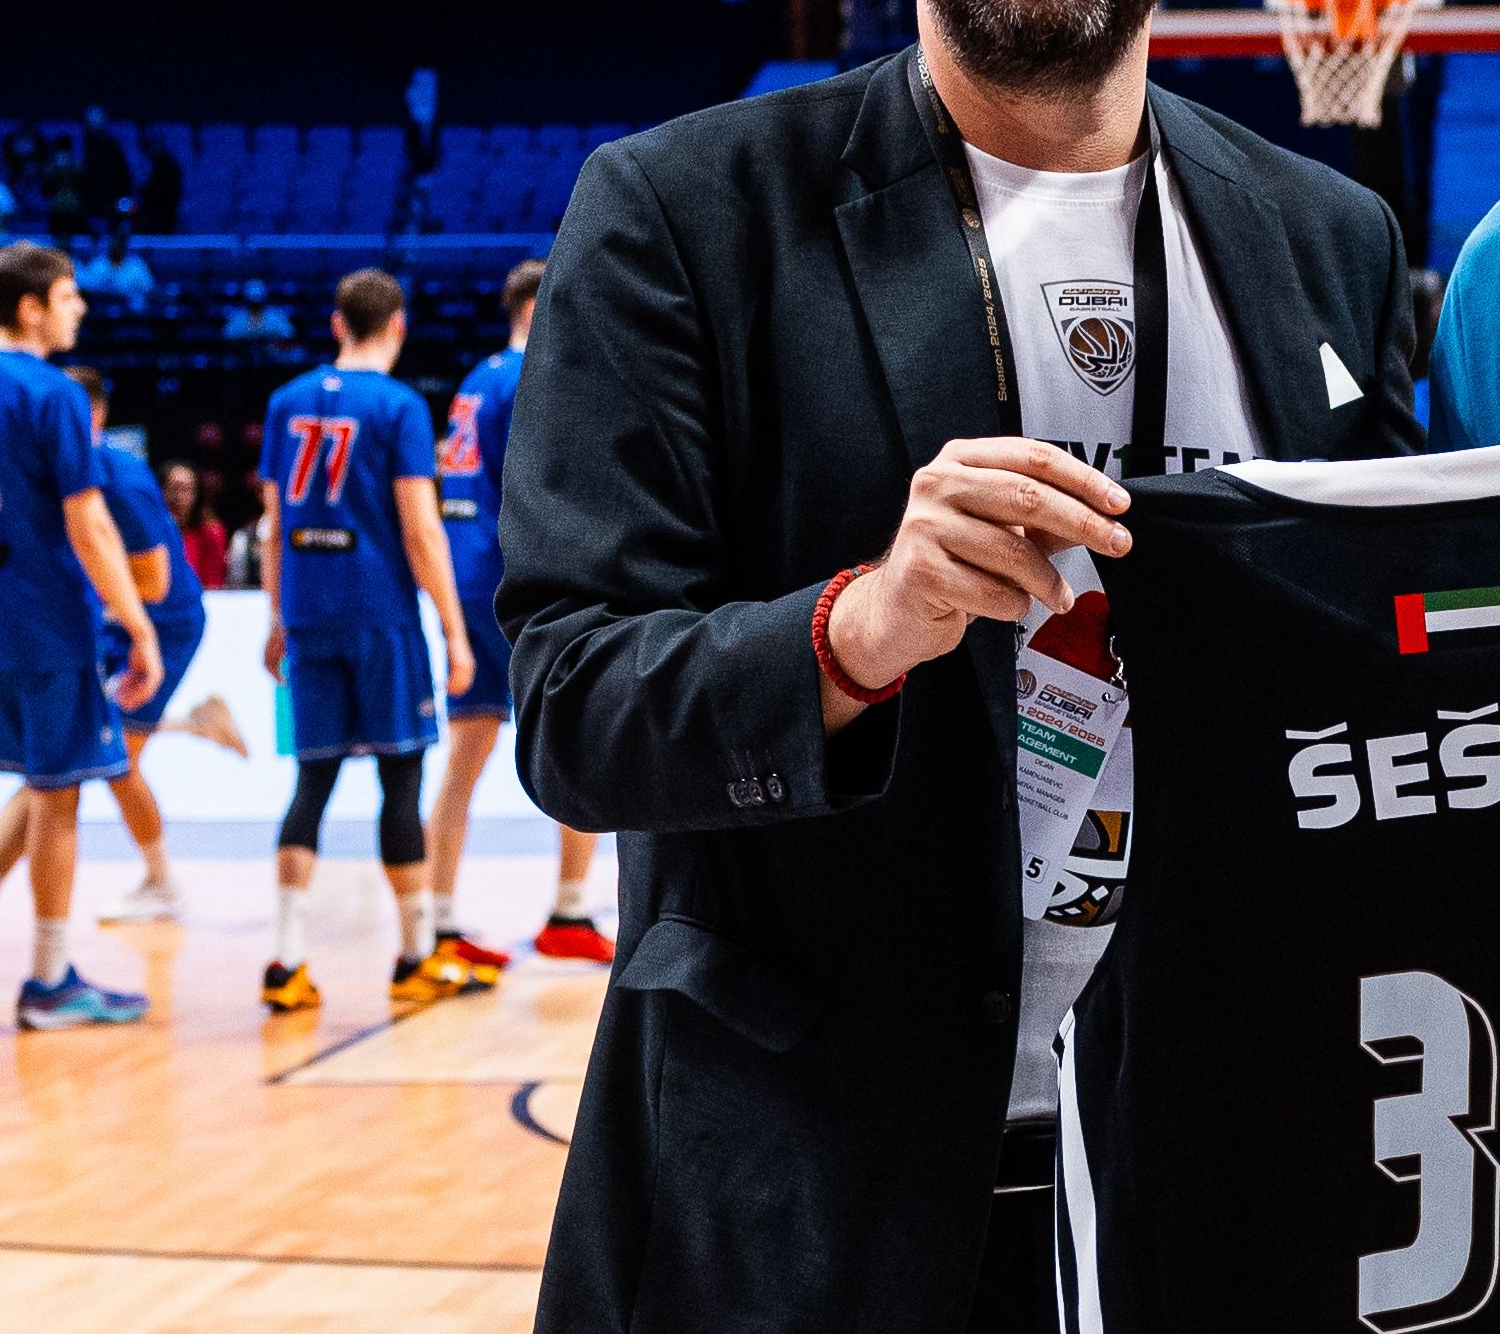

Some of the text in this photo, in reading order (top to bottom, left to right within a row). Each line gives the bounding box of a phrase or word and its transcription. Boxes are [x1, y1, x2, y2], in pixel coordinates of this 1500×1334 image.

[1058, 296, 1128, 307] DUBAI
[990, 350, 1008, 402] Season
[285, 415, 359, 507] 77
[1037, 690, 1094, 720] DUBAI
[1020, 720, 1057, 743] TEAM
[1026, 706, 1106, 747] 2024/2025
[1036, 787, 1066, 804] MANAGER
[1025, 856, 1044, 879] 5
